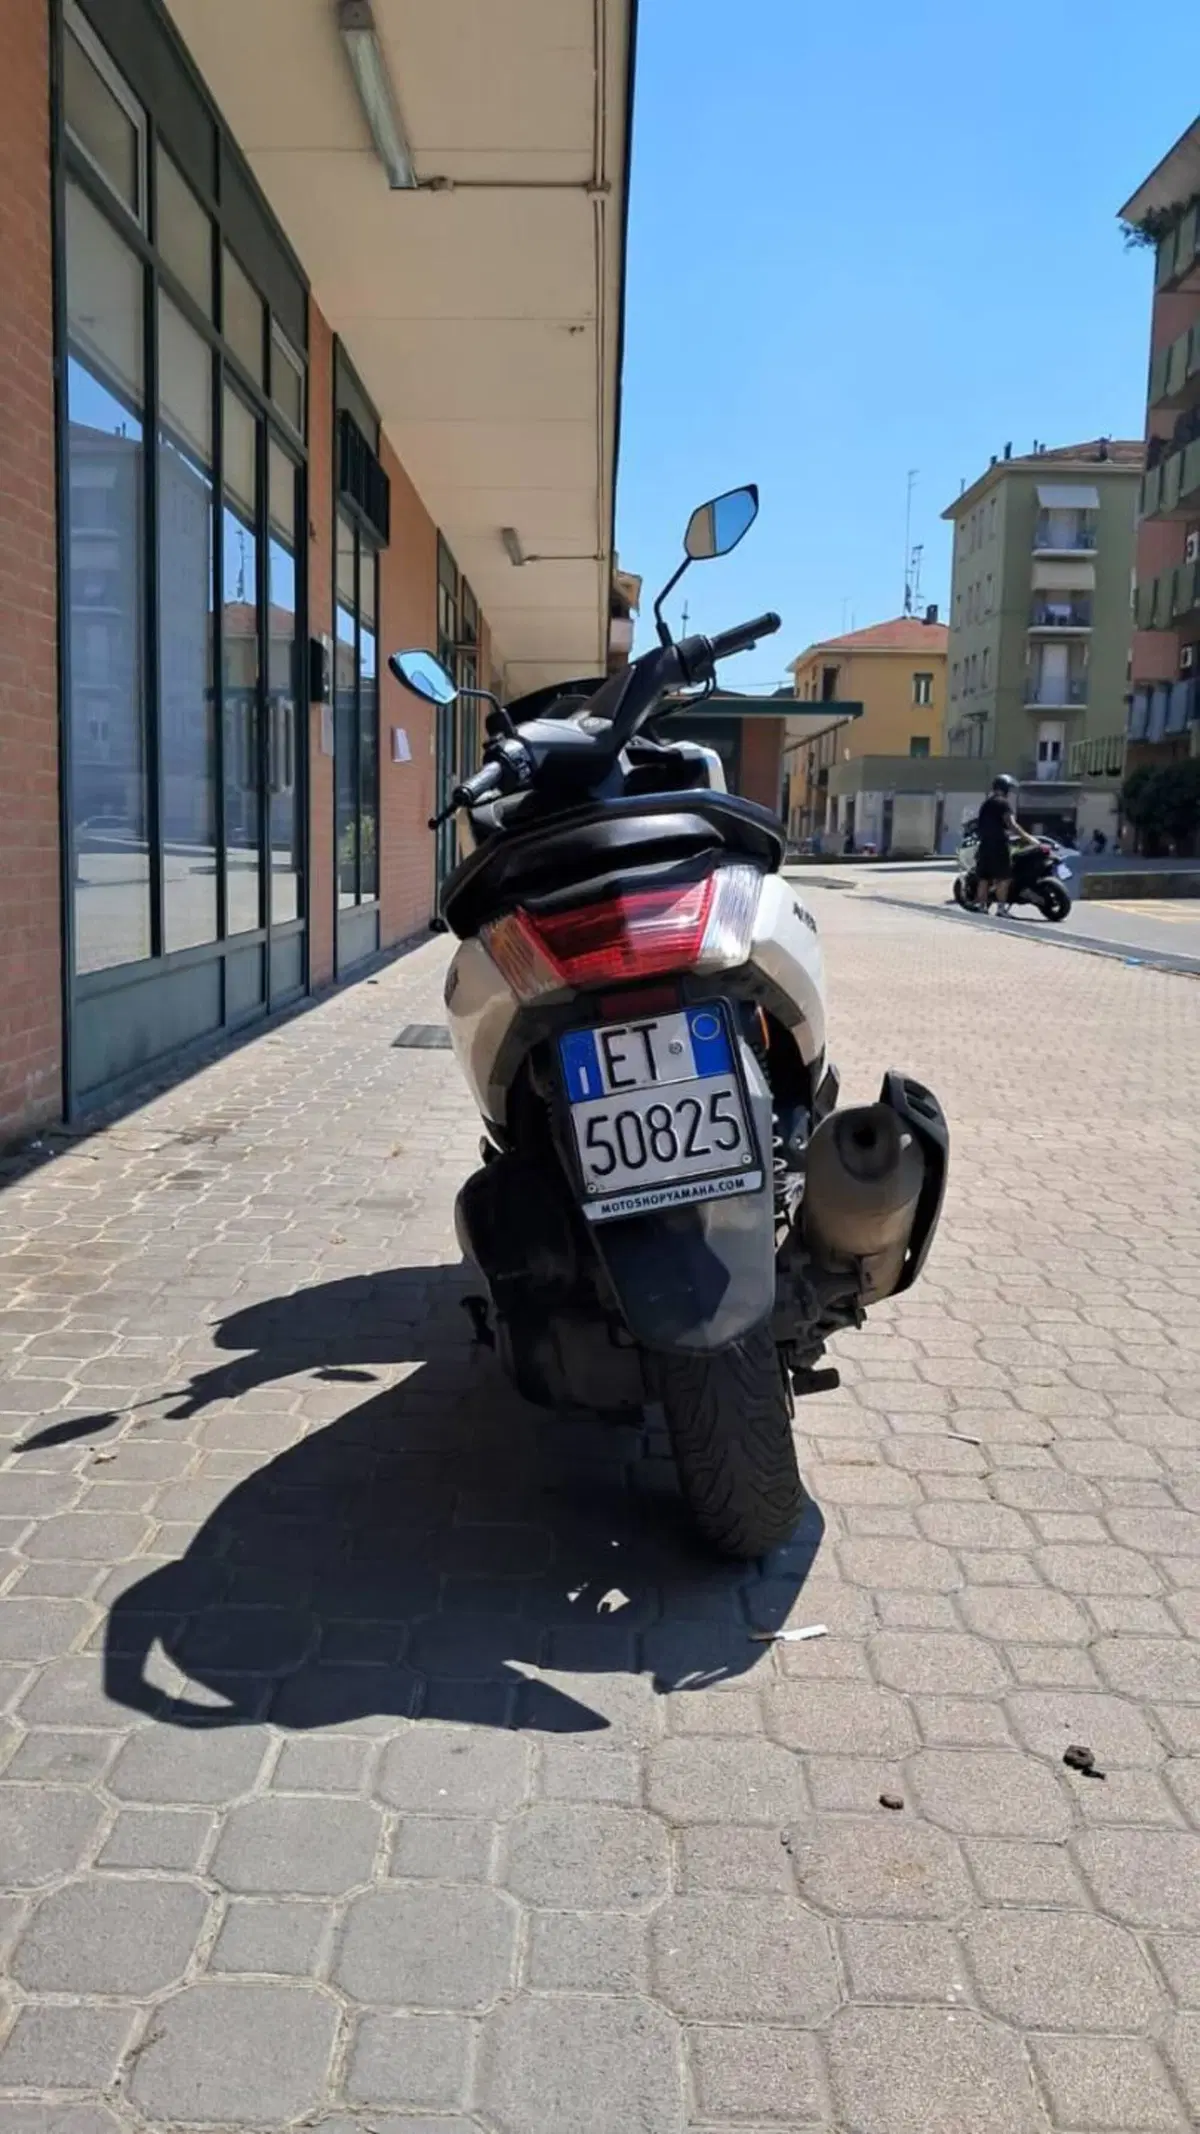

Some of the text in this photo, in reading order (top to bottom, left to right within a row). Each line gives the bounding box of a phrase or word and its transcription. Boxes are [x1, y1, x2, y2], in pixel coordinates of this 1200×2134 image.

[599, 1022, 658, 1088] ET
[586, 1090, 741, 1176] 50825
[600, 1178, 745, 1215] MOTOSHOPYAMAHA.COM
